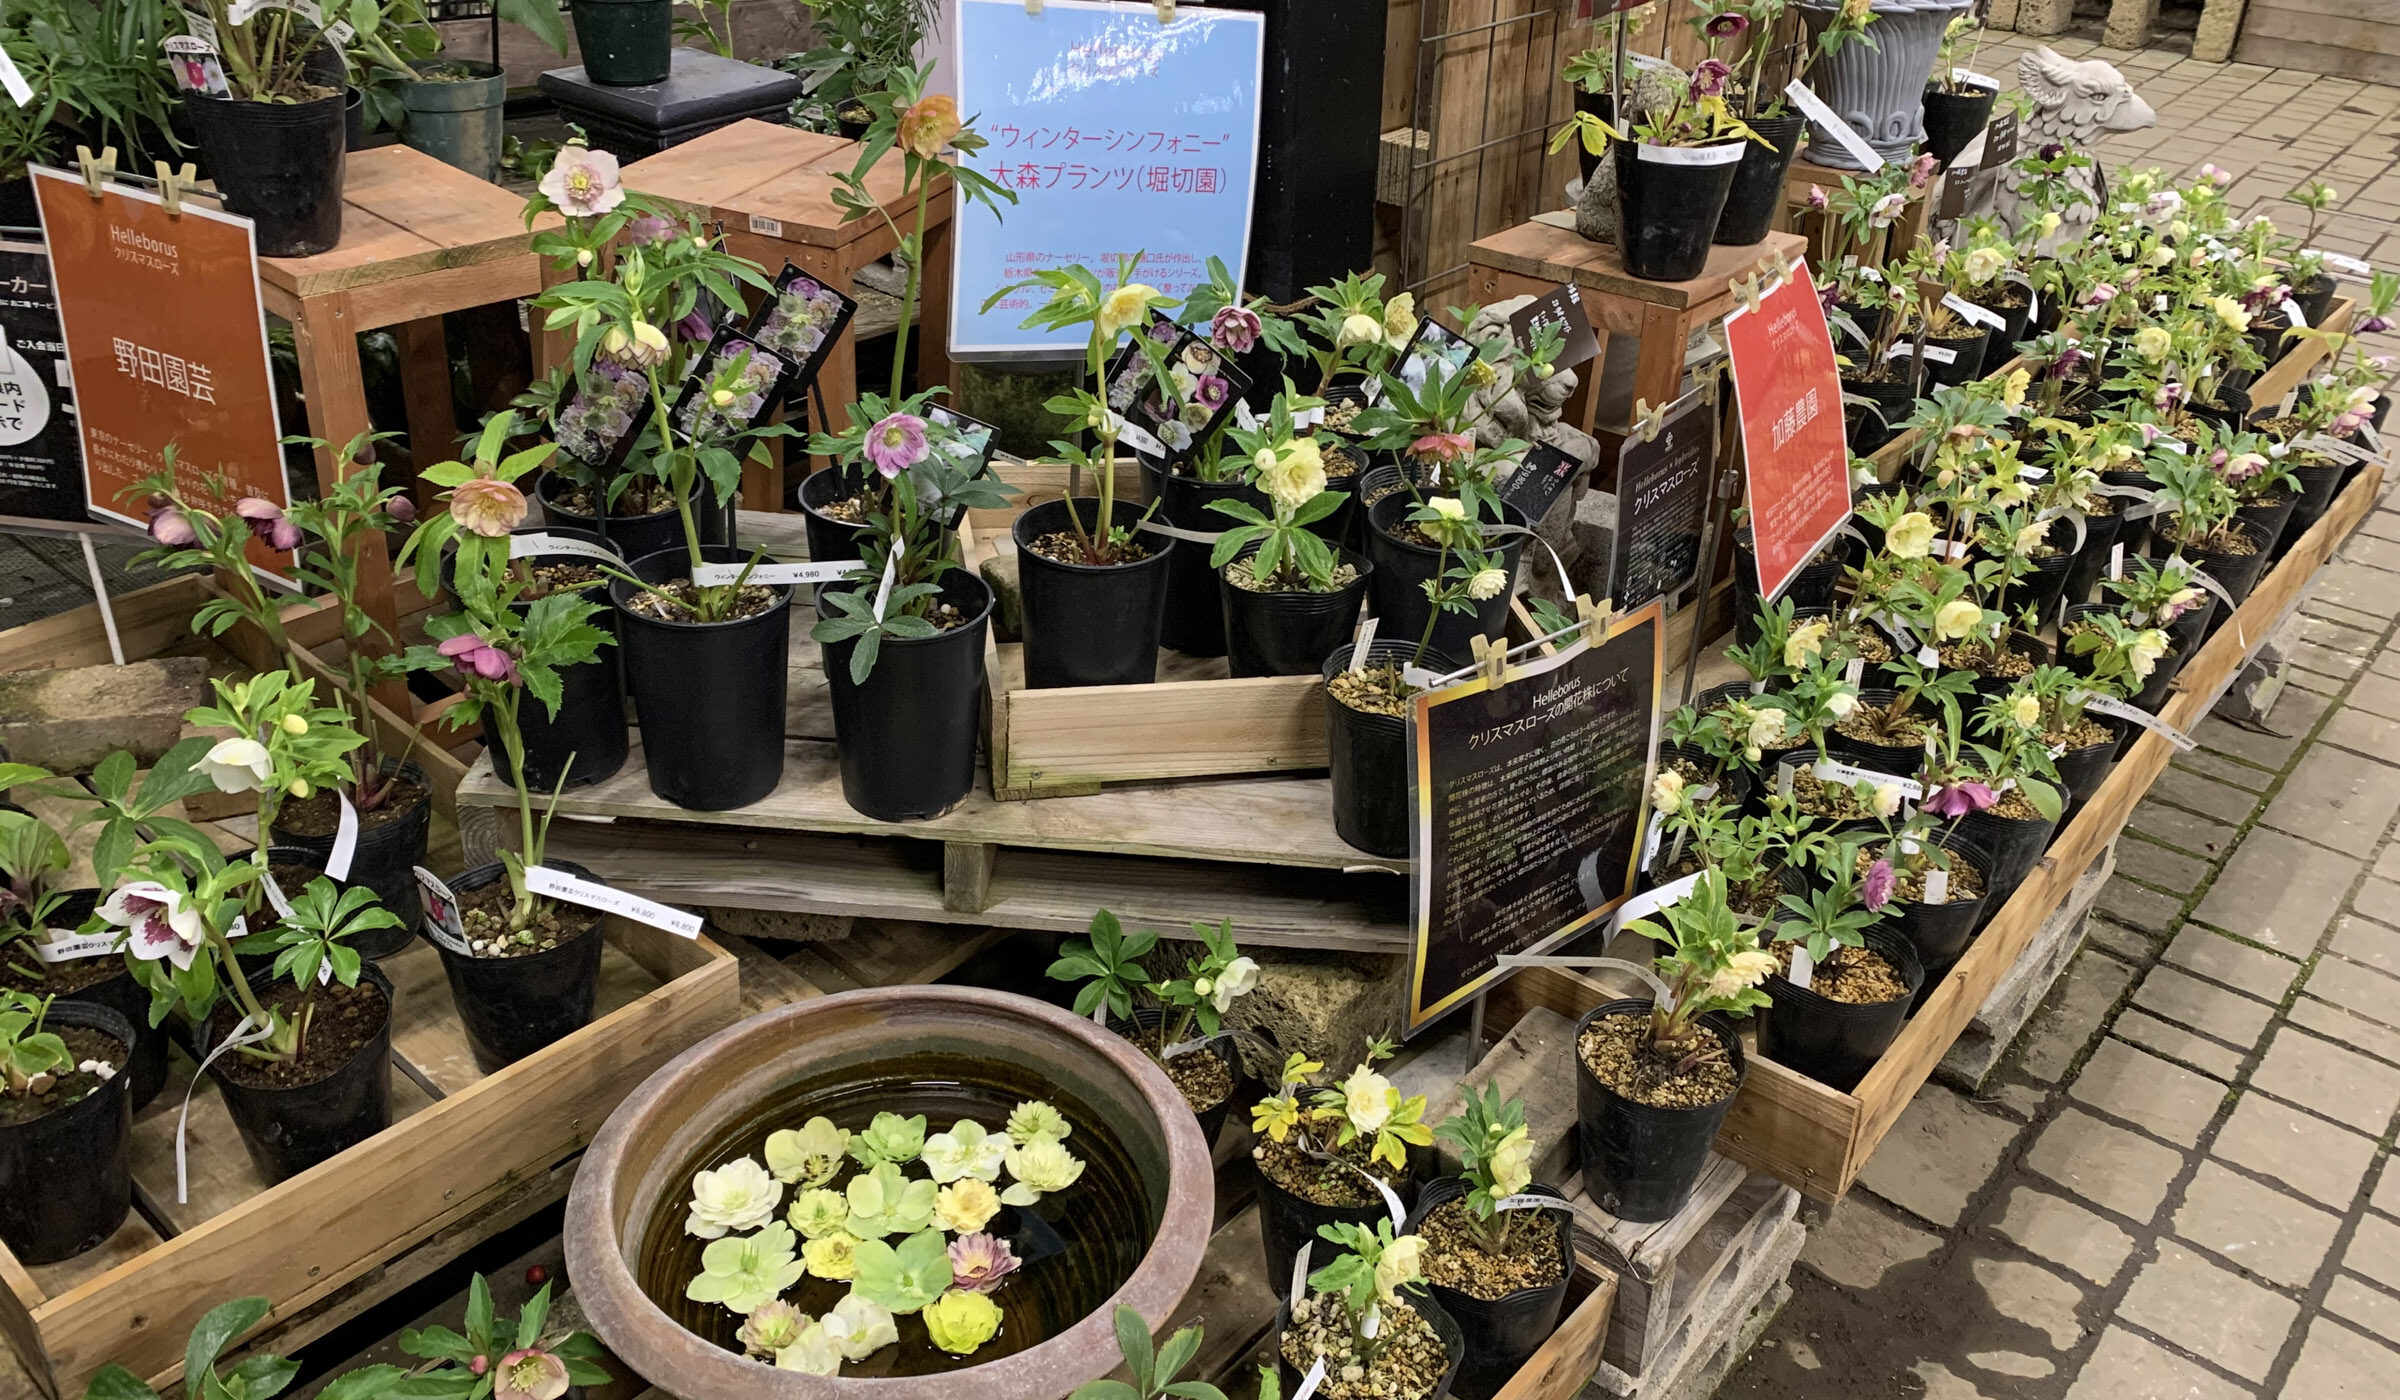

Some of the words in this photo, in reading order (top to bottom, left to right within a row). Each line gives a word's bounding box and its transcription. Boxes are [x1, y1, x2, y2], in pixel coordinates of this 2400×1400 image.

[110, 224, 178, 258] Helleborus
[113, 247, 180, 276] クリスマスローズ
[112, 336, 217, 406] 野田園芸
[1771, 387, 1818, 453] 加藤農園
[1634, 457, 1700, 516] クリスマスローズ
[792, 569, 820, 579] ¥4,980
[1468, 667, 1630, 750] クリスマスローズの開花株について
[1532, 676, 1582, 709] Helleborus
[630, 905, 656, 921] ¥6,800
[671, 919, 696, 934] ¥6,800
